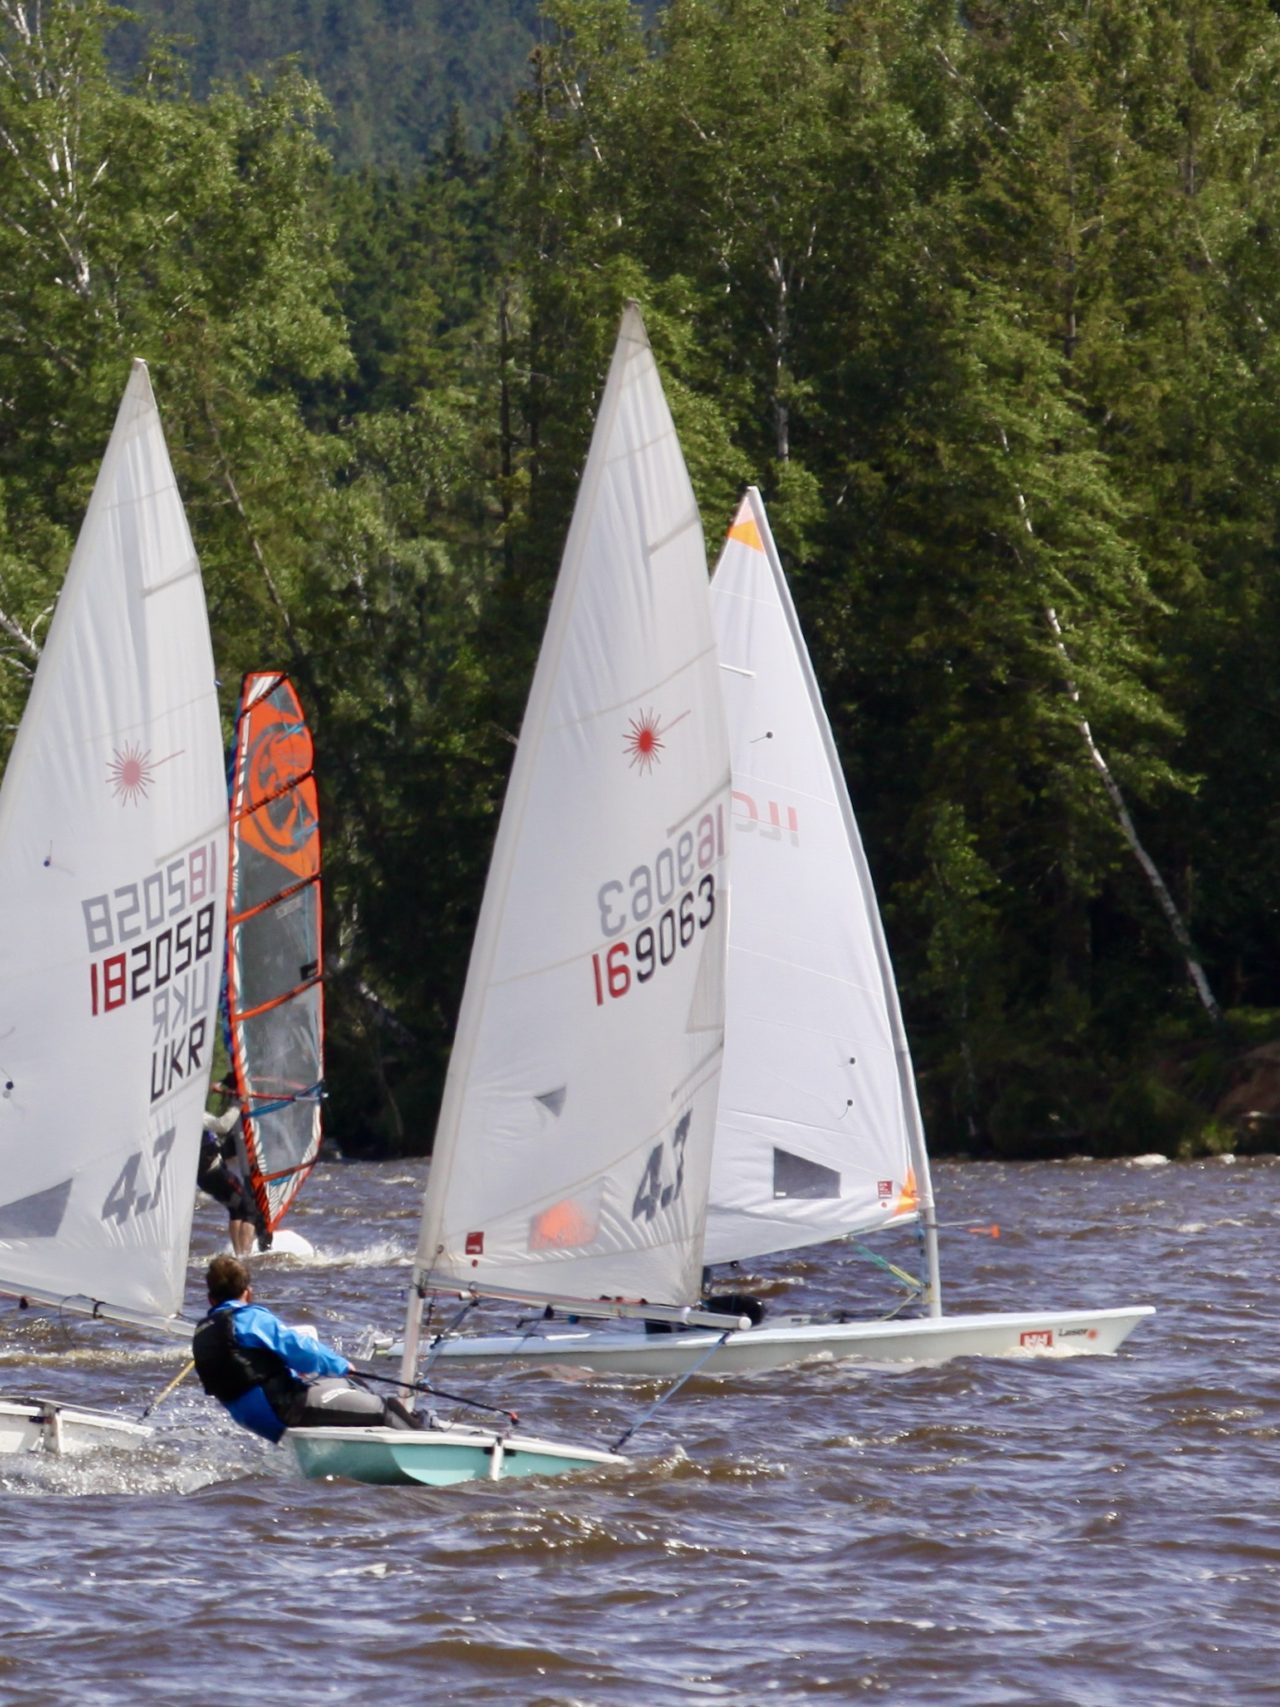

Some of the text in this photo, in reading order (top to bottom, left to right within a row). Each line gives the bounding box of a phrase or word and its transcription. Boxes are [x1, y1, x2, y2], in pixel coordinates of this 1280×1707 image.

[90, 900, 215, 1017] 182058
[591, 874, 716, 1006] 169063
[150, 1017, 206, 1102] UKR
[101, 1126, 176, 1227] 4.7
[631, 1109, 692, 1222] 4.7
